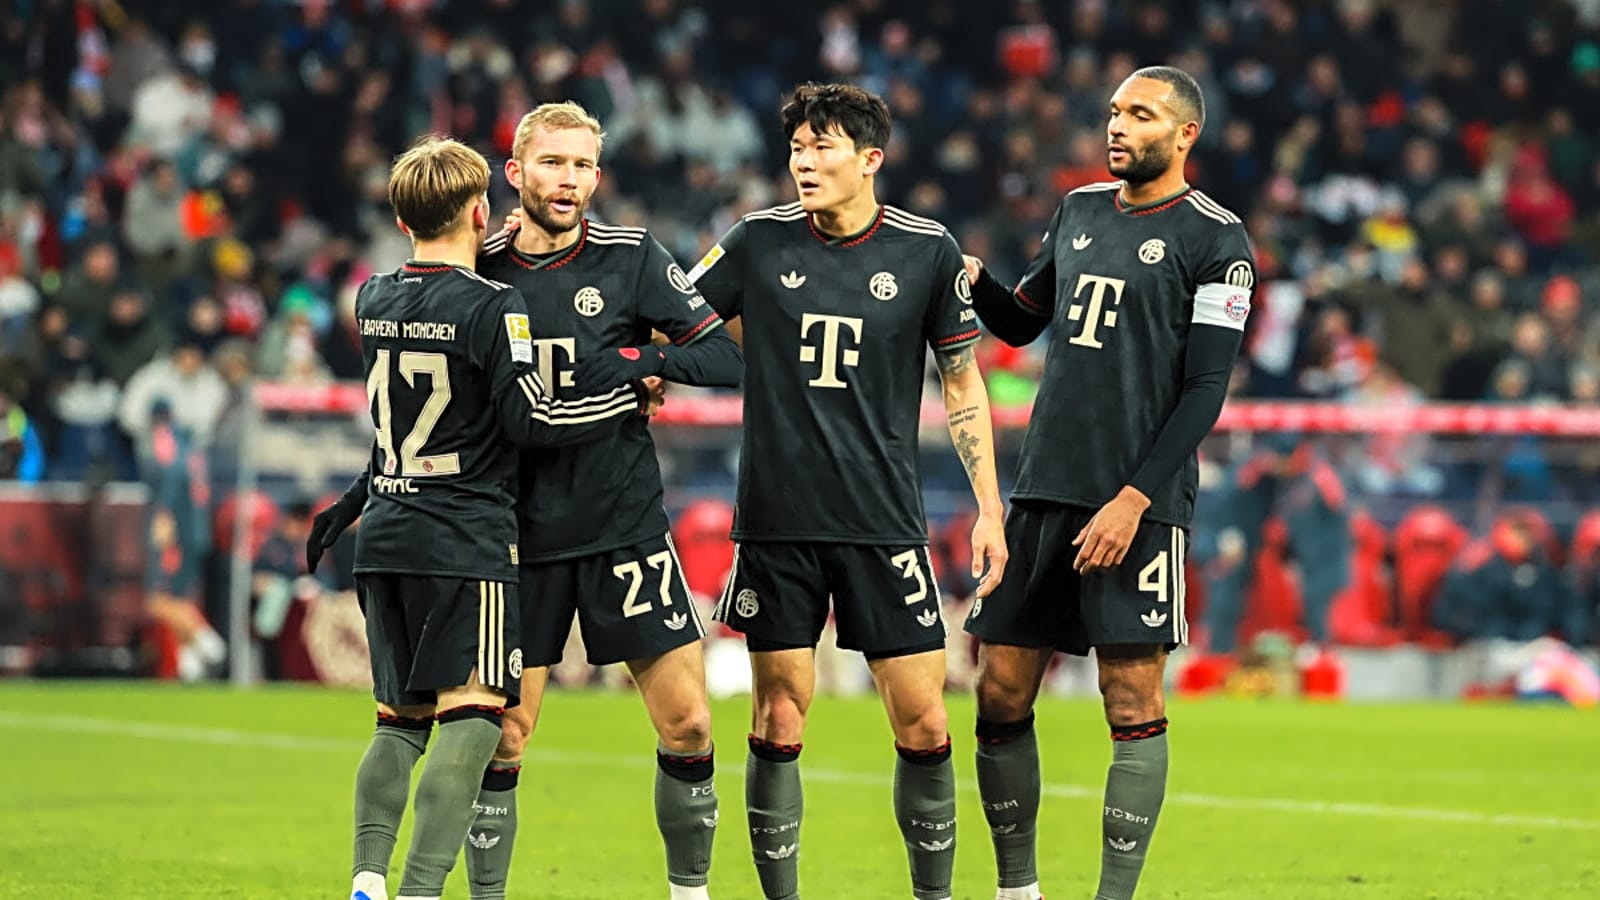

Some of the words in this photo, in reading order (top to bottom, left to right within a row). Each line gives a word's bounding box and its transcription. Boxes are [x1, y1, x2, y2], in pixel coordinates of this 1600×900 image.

[363, 319, 399, 338] BAYERN
[1067, 273, 1126, 349] T
[799, 312, 862, 390] T
[366, 349, 461, 477] 42
[612, 550, 673, 618] 27
[891, 548, 928, 606] 3
[1138, 550, 1168, 602] 4
